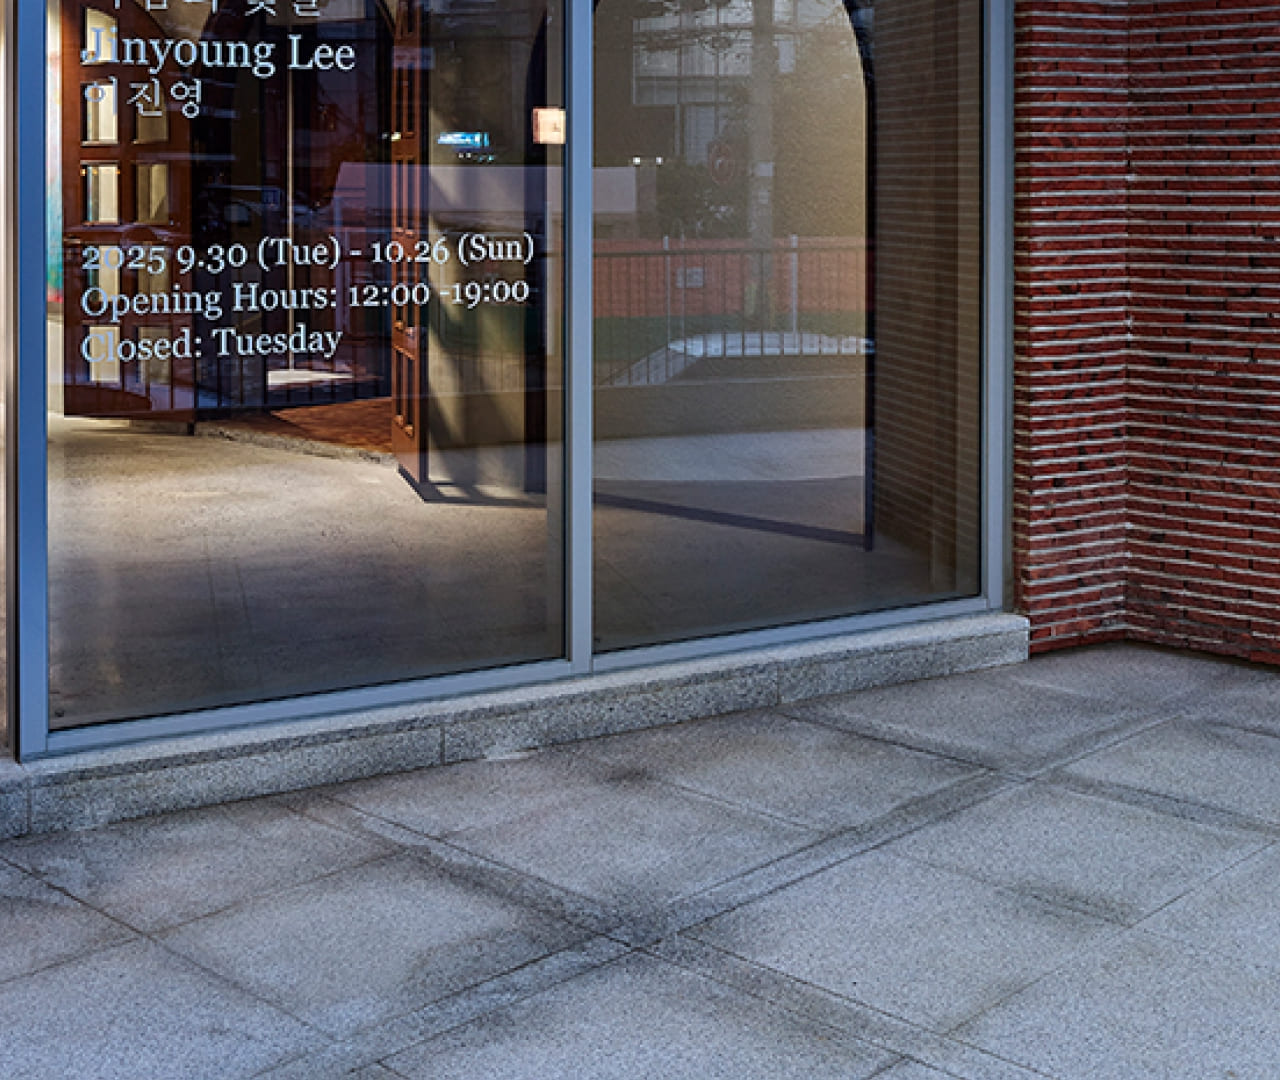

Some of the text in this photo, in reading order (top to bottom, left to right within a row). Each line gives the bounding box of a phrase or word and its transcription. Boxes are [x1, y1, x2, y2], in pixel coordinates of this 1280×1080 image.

[80, 27, 356, 78] Jinyoung Lee
[81, 245, 167, 273] 2025
[176, 244, 248, 273] 9.30
[258, 235, 341, 271] (Tue)
[371, 237, 449, 265] 10.26
[458, 232, 535, 266] (Sun)
[81, 283, 224, 322] Opening
[233, 282, 338, 312] Hours:
[349, 283, 429, 308] 12:00
[81, 322, 343, 362] Closed: Tuesday
